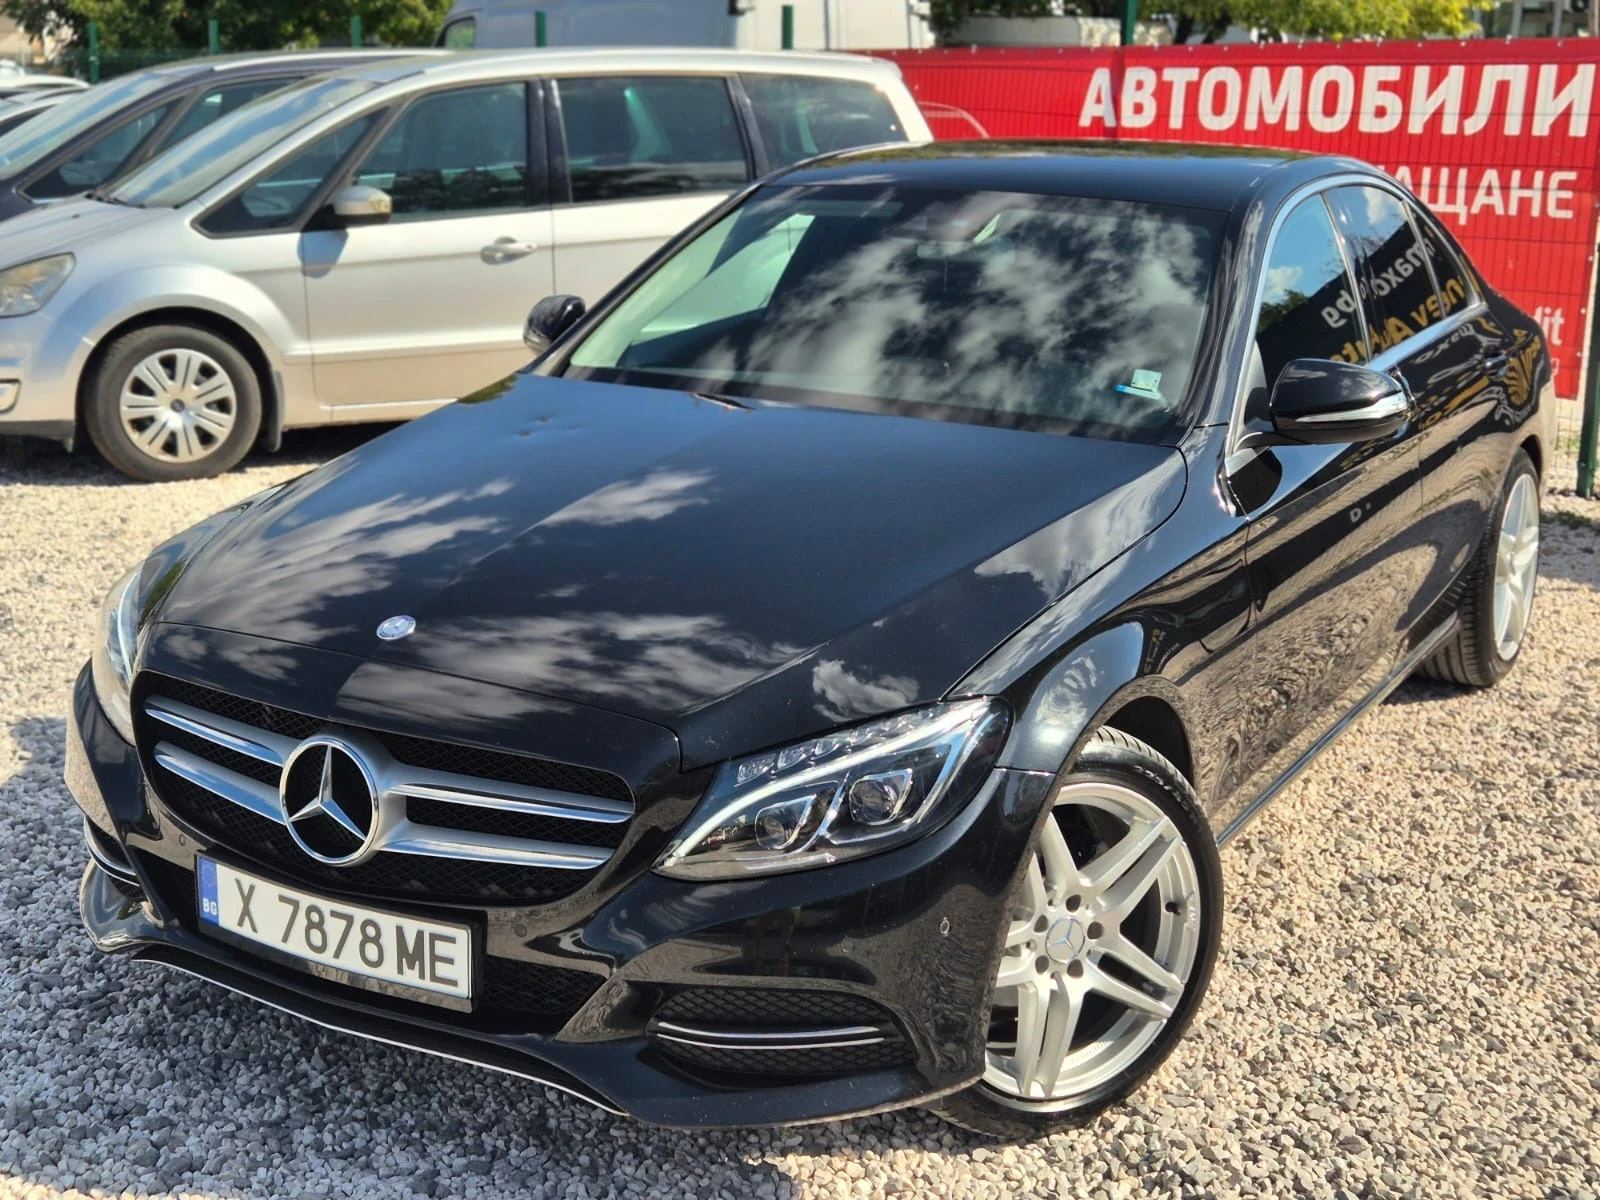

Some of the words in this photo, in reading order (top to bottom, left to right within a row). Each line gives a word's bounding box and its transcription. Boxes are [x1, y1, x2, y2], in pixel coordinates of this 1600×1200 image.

[1078, 63, 1597, 138] АВТОМОБИЛИ
[1376, 165, 1578, 226] ЩАНЕ
[202, 896, 218, 916] BG
[234, 878, 258, 934] X
[277, 893, 385, 970] 7878
[395, 924, 459, 988] ME
